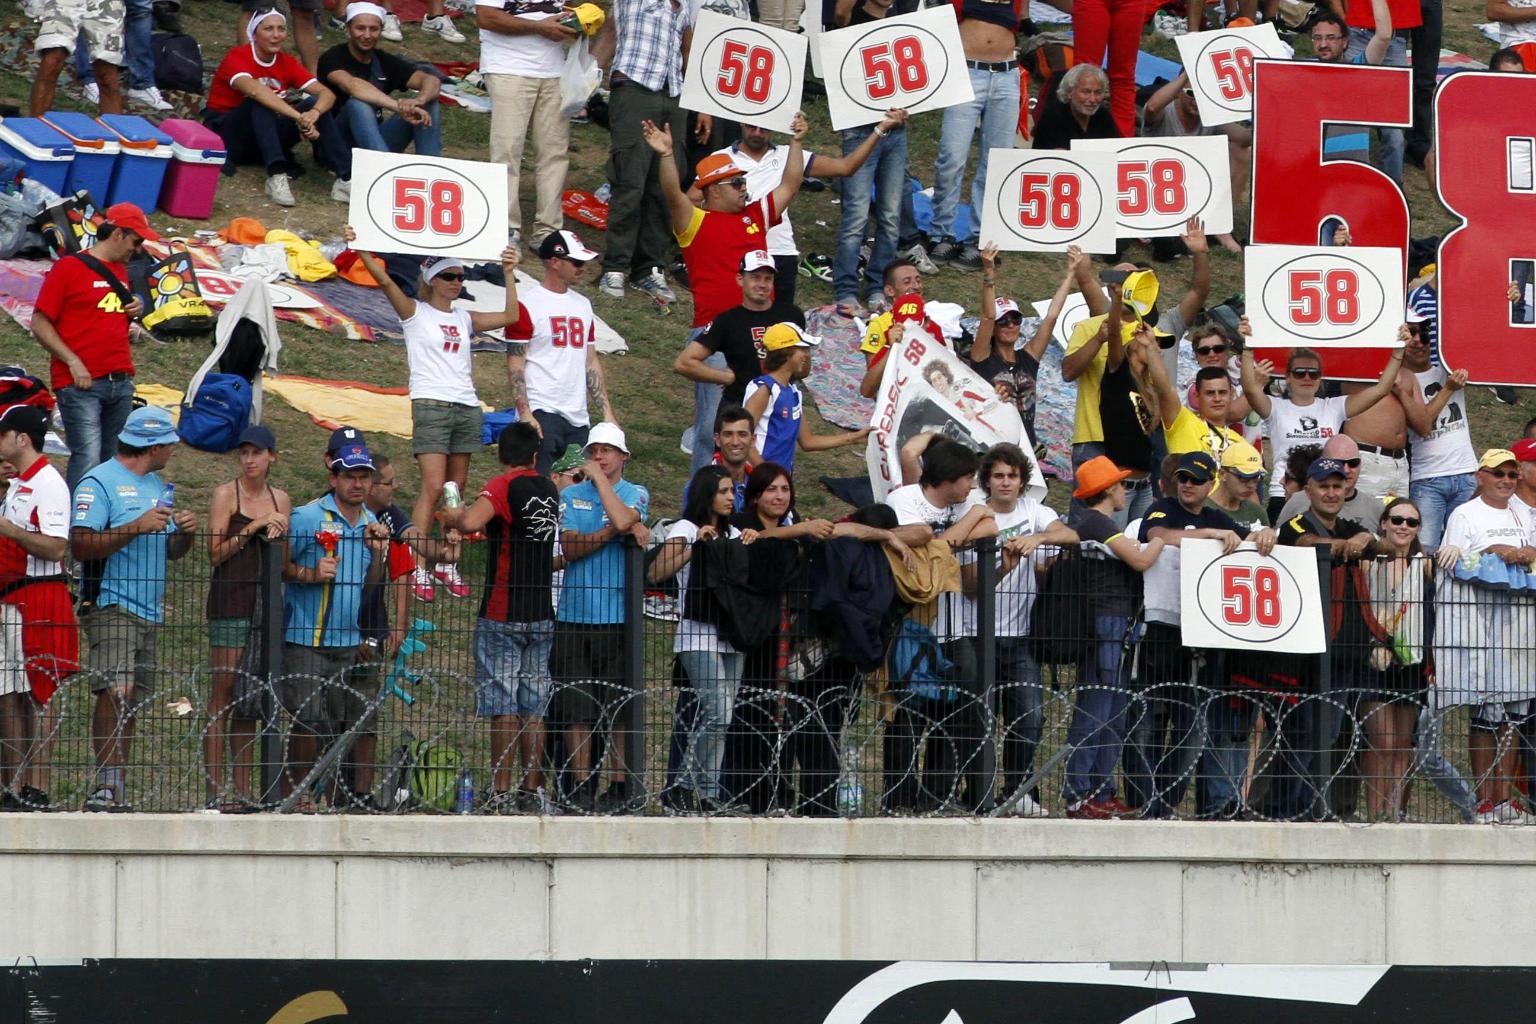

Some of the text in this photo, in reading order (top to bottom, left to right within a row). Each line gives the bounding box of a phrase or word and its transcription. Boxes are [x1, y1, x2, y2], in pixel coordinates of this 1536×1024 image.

[714, 39, 776, 105] 58
[859, 35, 930, 101] 58
[392, 177, 464, 236] 58
[1017, 172, 1082, 230] 58
[1114, 158, 1187, 216] 58
[898, 303, 918, 315] 46
[1287, 269, 1360, 326] 58
[549, 315, 584, 349] 58
[903, 338, 927, 367] 58
[1220, 565, 1283, 628] 58
